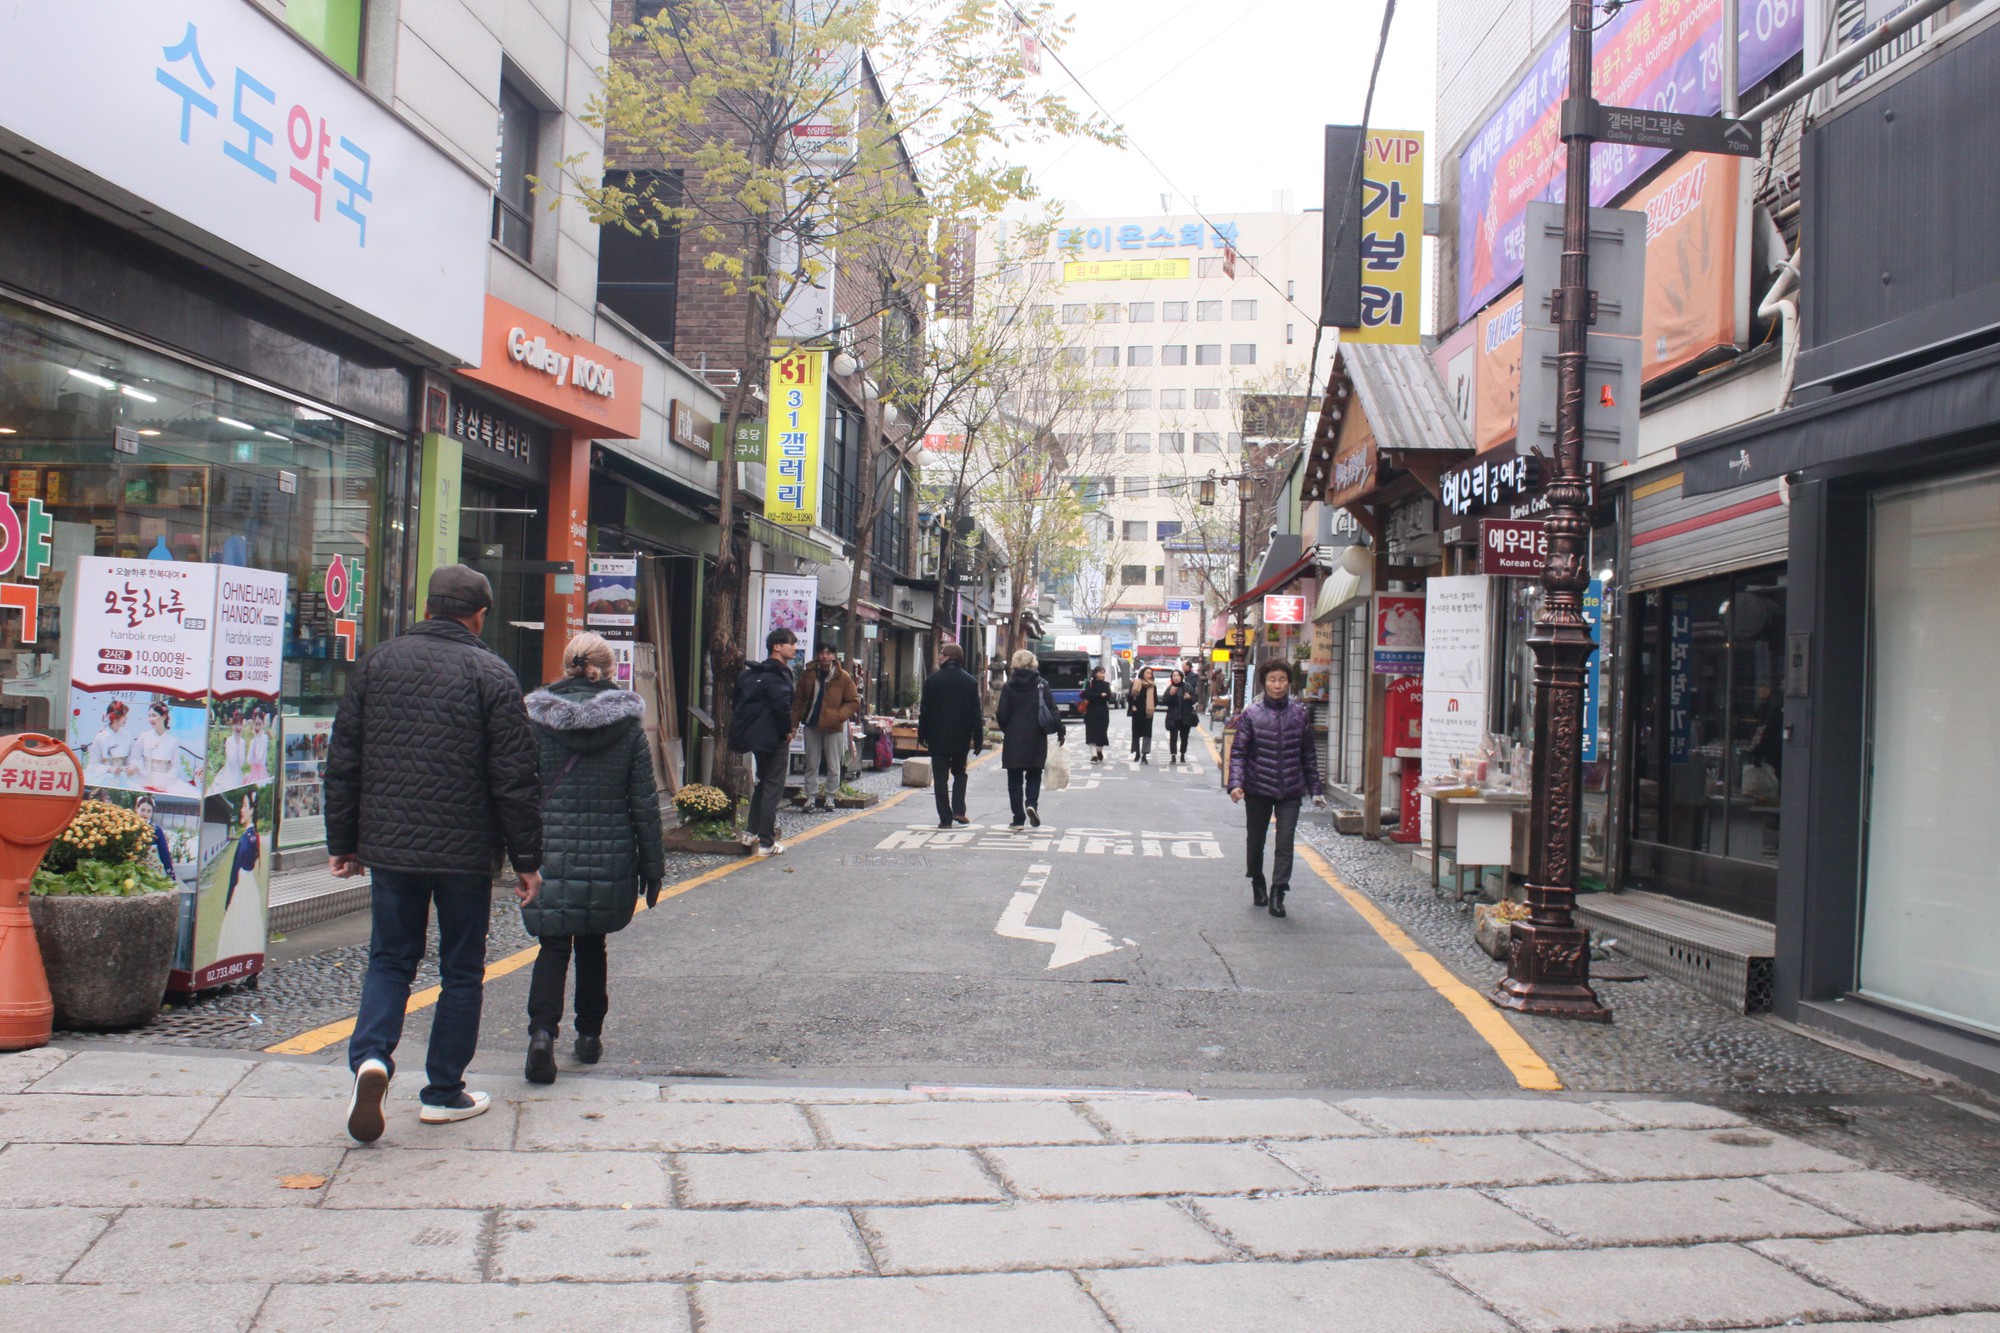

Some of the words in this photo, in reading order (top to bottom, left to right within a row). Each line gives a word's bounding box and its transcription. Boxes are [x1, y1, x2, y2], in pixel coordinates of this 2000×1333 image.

[1608, 112, 1685, 136] 갤러리그림손
[155, 21, 373, 249] 수도약국
[1637, 132, 1671, 144] Grimson
[1727, 140, 1749, 151] 70m
[1057, 222, 1241, 253] 라이온스회관
[507, 327, 570, 386] Gallery
[571, 354, 616, 400] KOSA
[467, 407, 530, 465] 상록갤러리
[767, 512, 813, 522] 02-732-1290
[115, 567, 147, 577] 오늘하루
[148, 568, 180, 579] 한복대여
[1500, 558, 1530, 568] Korean
[222, 581, 282, 606] OHNELHARU
[105, 581, 186, 628] 오늘하루
[221, 603, 263, 625] HANBOK
[325, 553, 364, 662] 약
[1270, 597, 1299, 621] 꽃
[110, 629, 146, 641] hanbok
[148, 633, 176, 643] rental
[225, 628, 252, 645] hanbok
[253, 631, 274, 647] rental
[104, 650, 126, 660] 2시간
[103, 664, 125, 674] 4시간
[1410, 693, 1423, 702] PO
[1, 768, 73, 792] 주차금지
[206, 962, 243, 982] 02.733.4943
